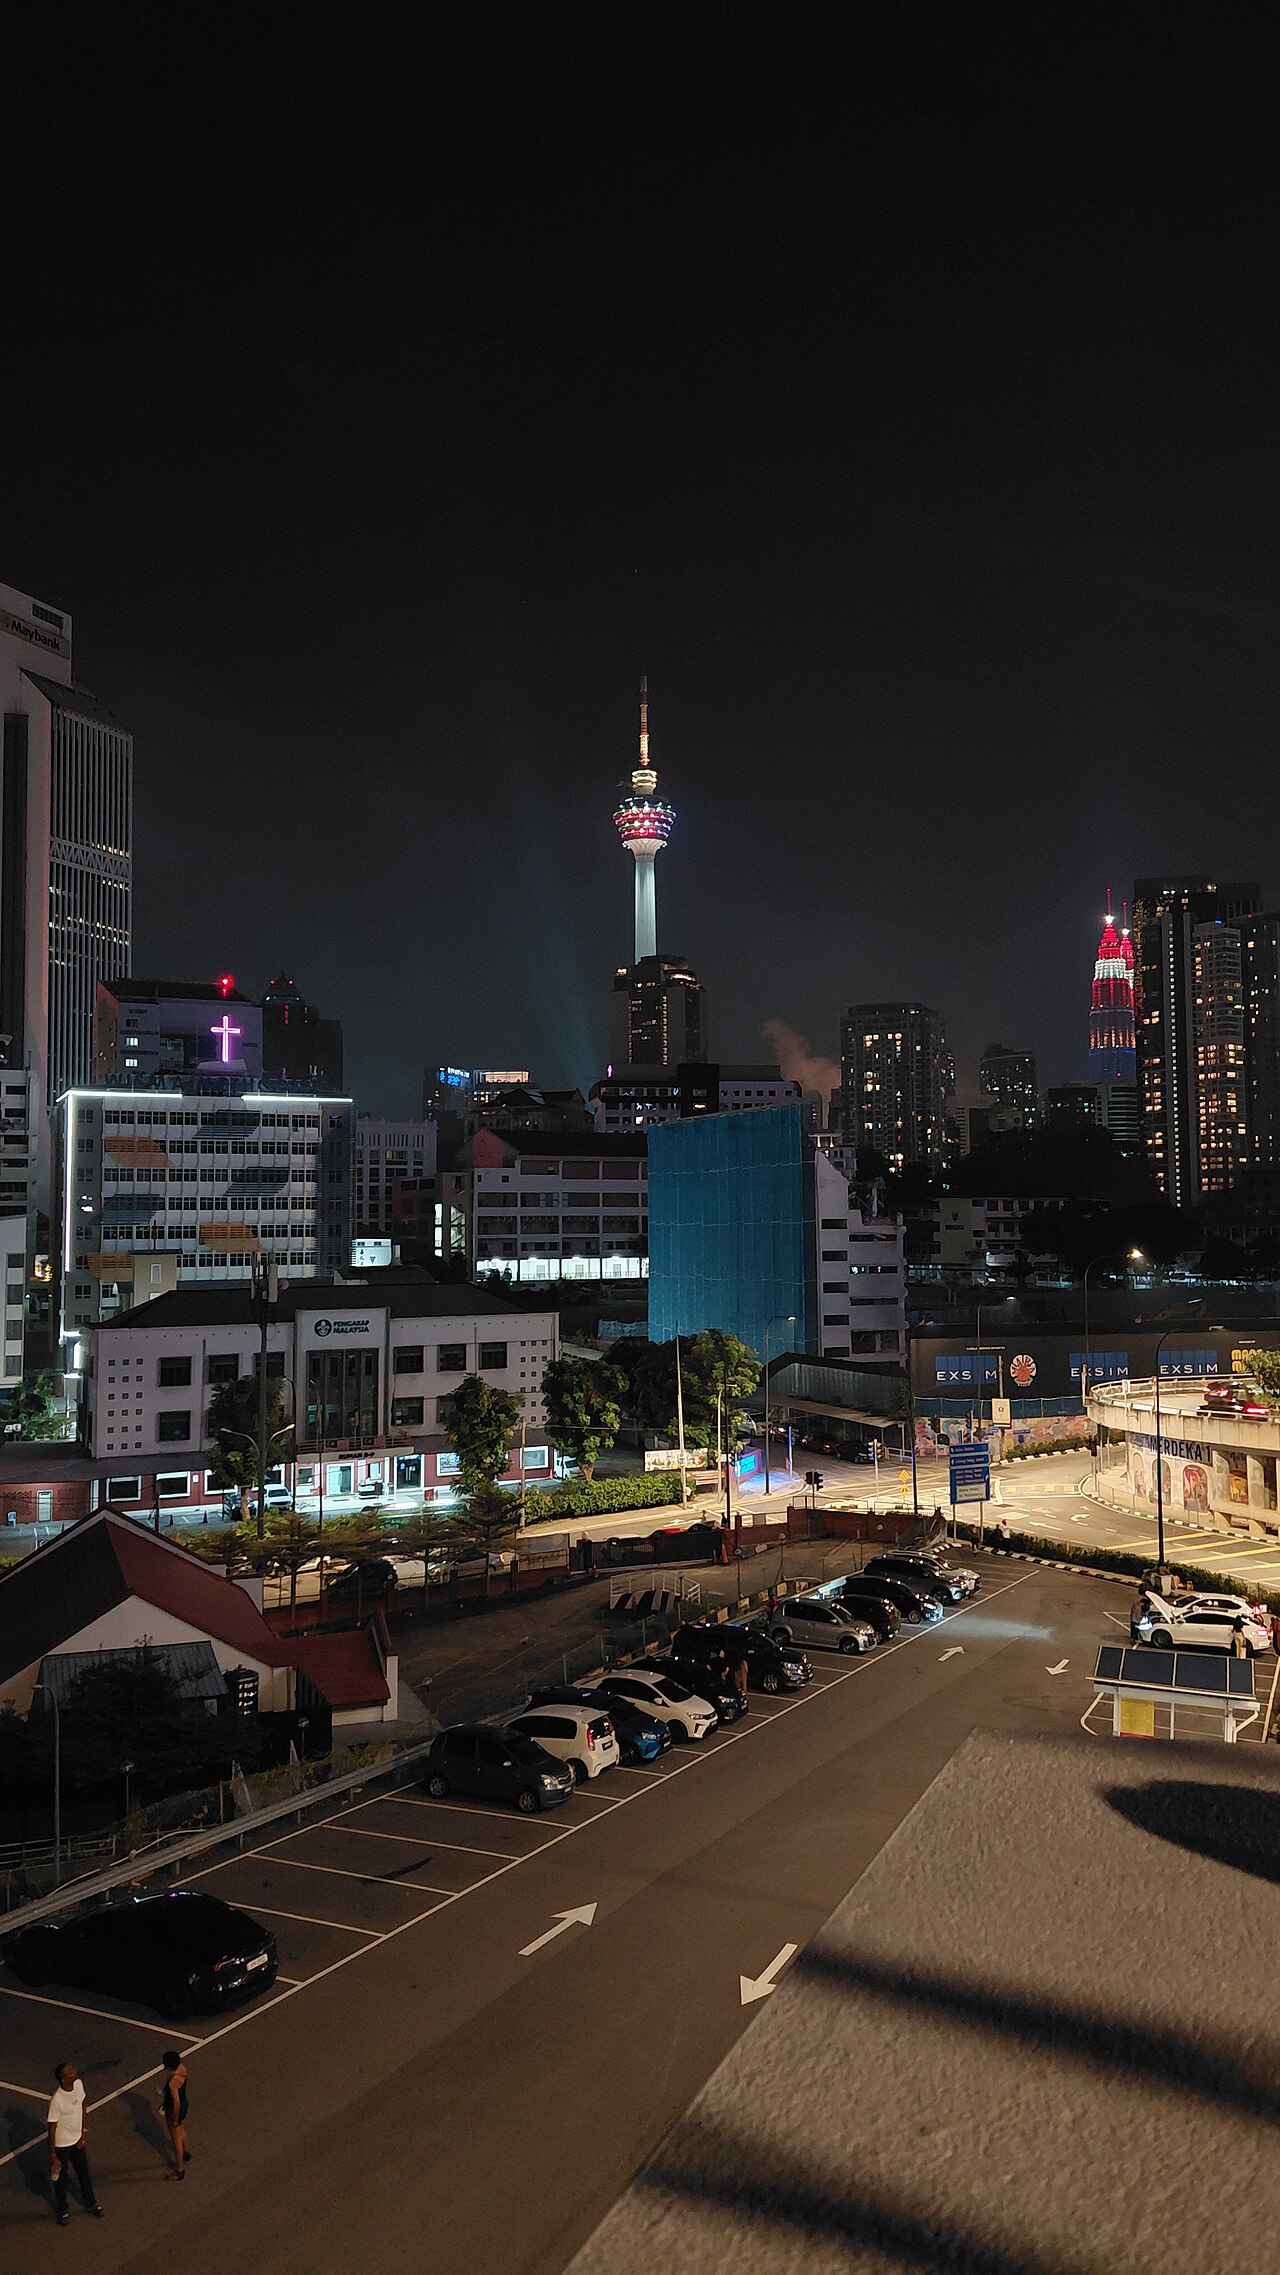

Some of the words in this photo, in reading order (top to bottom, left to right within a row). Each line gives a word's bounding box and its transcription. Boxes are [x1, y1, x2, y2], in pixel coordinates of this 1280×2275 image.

[11, 620, 60, 650] Maybank
[333, 1326, 370, 1334] MALAYSIA
[1159, 1363, 1219, 1375] EXSIM
[936, 1370, 998, 1381] EXSM
[1150, 1435, 1203, 1462] MERDEKA
[1205, 1444, 1212, 1463] 1
